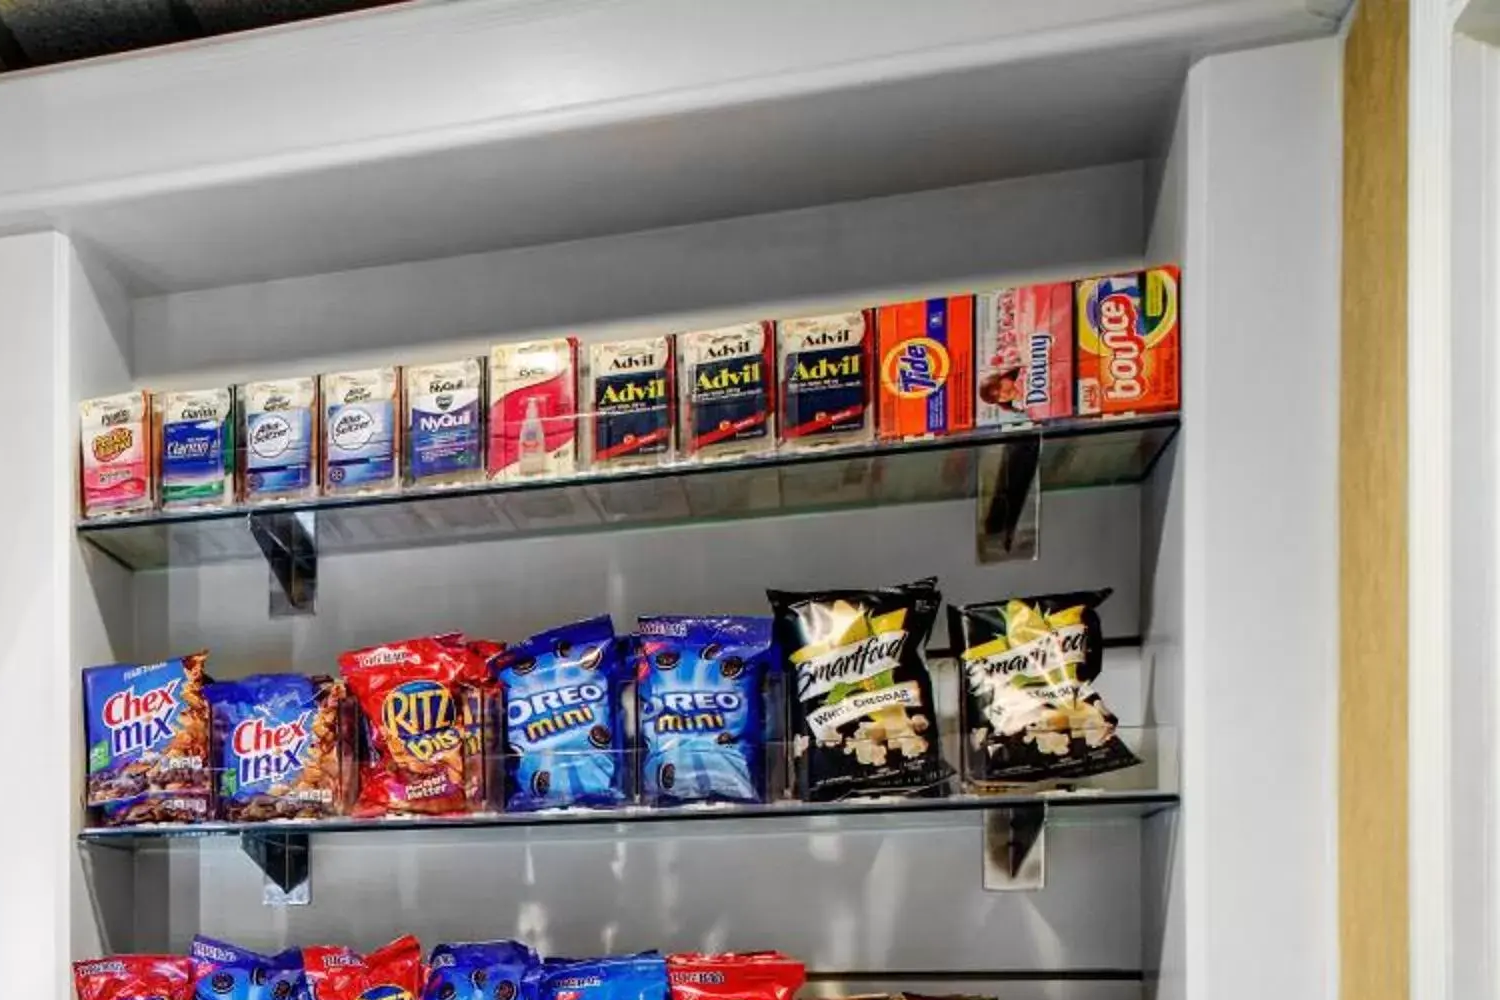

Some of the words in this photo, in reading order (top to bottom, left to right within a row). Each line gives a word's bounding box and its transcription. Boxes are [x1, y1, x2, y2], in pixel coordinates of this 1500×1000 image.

[706, 341, 750, 359] Advil
[801, 329, 851, 348] Advil
[609, 353, 654, 370] Advil
[695, 363, 760, 391] Advil
[793, 354, 861, 381] Advil
[900, 342, 941, 394] Tide
[1026, 335, 1052, 404] Downy
[599, 378, 665, 405] Advil
[419, 410, 471, 432] NyQuil
[798, 632, 908, 693] Smartfood
[104, 677, 181, 728] Chex
[385, 686, 450, 735] RITZ
[508, 683, 602, 727] OREO
[643, 691, 740, 716] OREO
[112, 708, 176, 755] mix
[233, 710, 311, 755] Chex
[526, 704, 594, 741] mini
[656, 712, 725, 733] mini
[241, 739, 305, 784] mix
